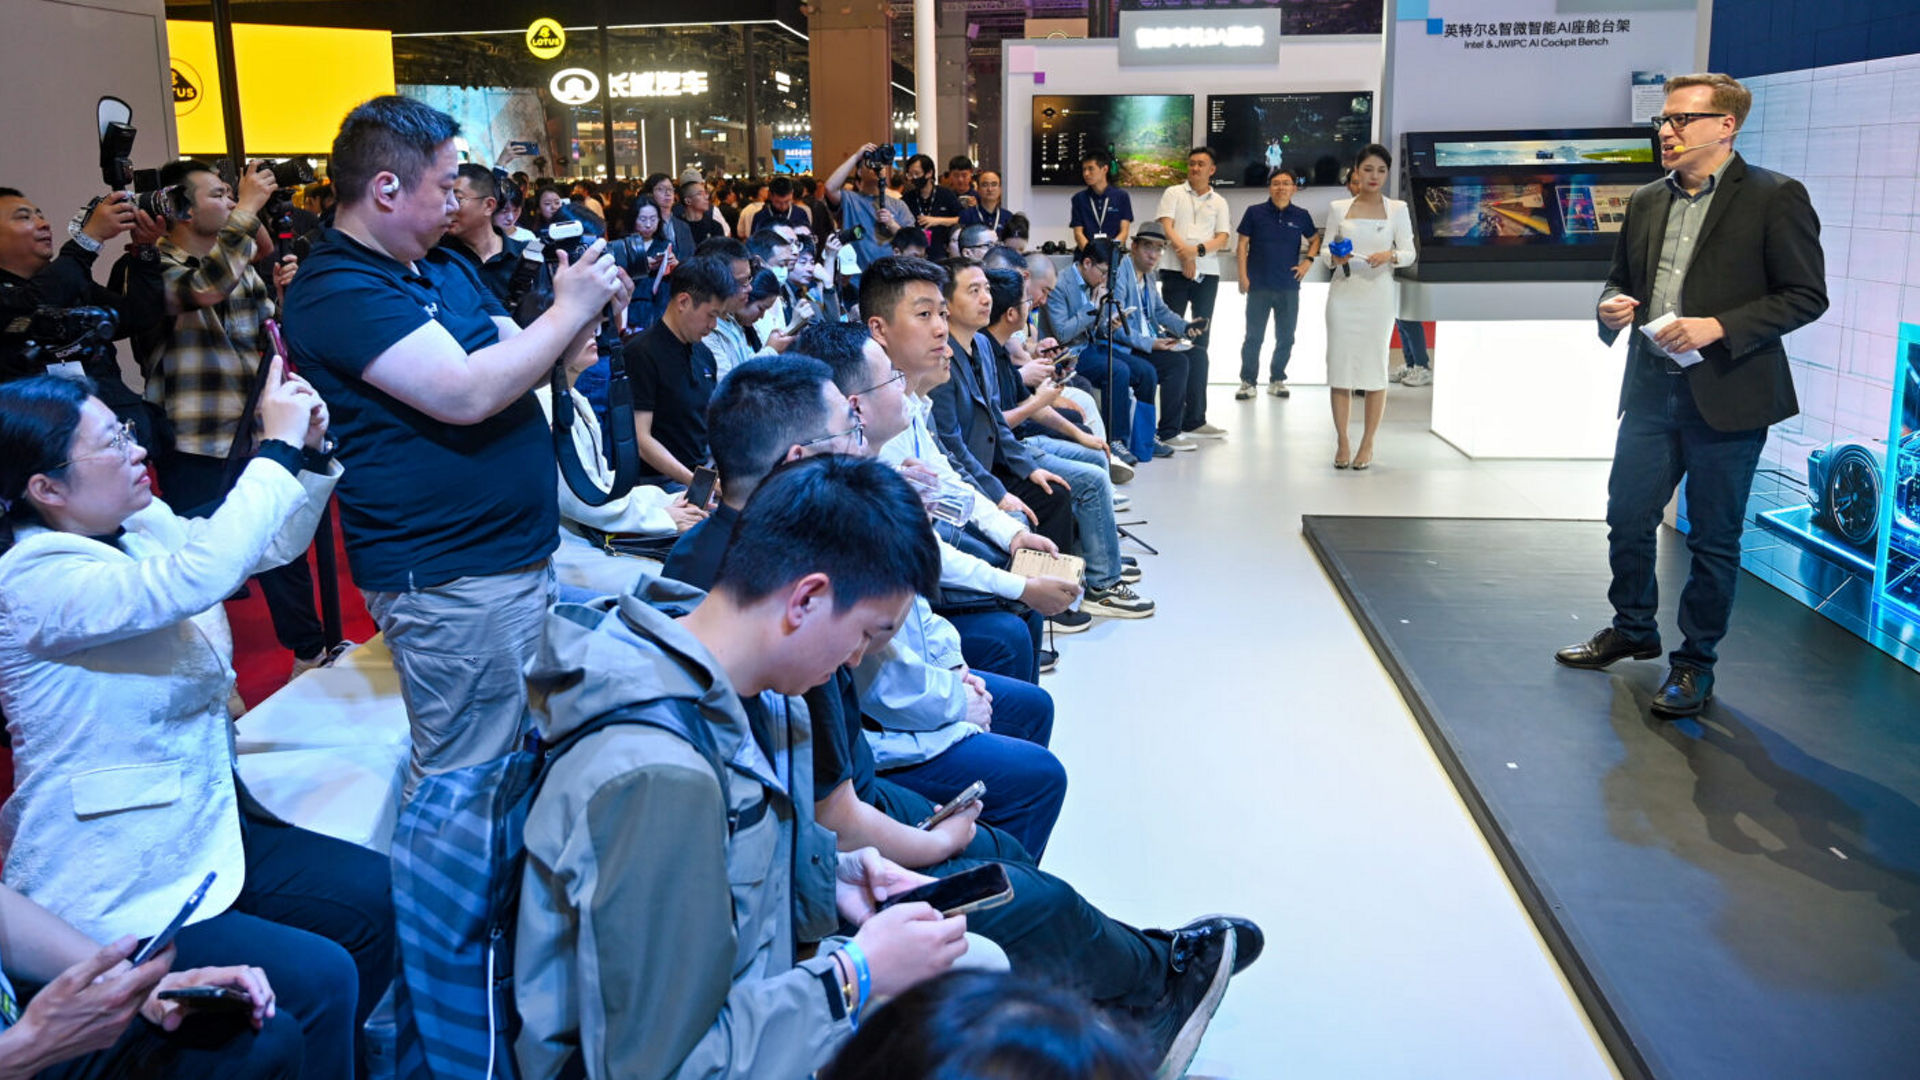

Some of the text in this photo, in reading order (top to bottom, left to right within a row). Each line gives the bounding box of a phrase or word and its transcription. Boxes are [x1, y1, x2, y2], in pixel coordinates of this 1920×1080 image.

[1444, 19, 1630, 37] 英特尔&智微智能AI座舱台架
[532, 38, 560, 47] LOTUS
[1464, 37, 1609, 49] Intel & JWIPC AI Cockpit Bench
